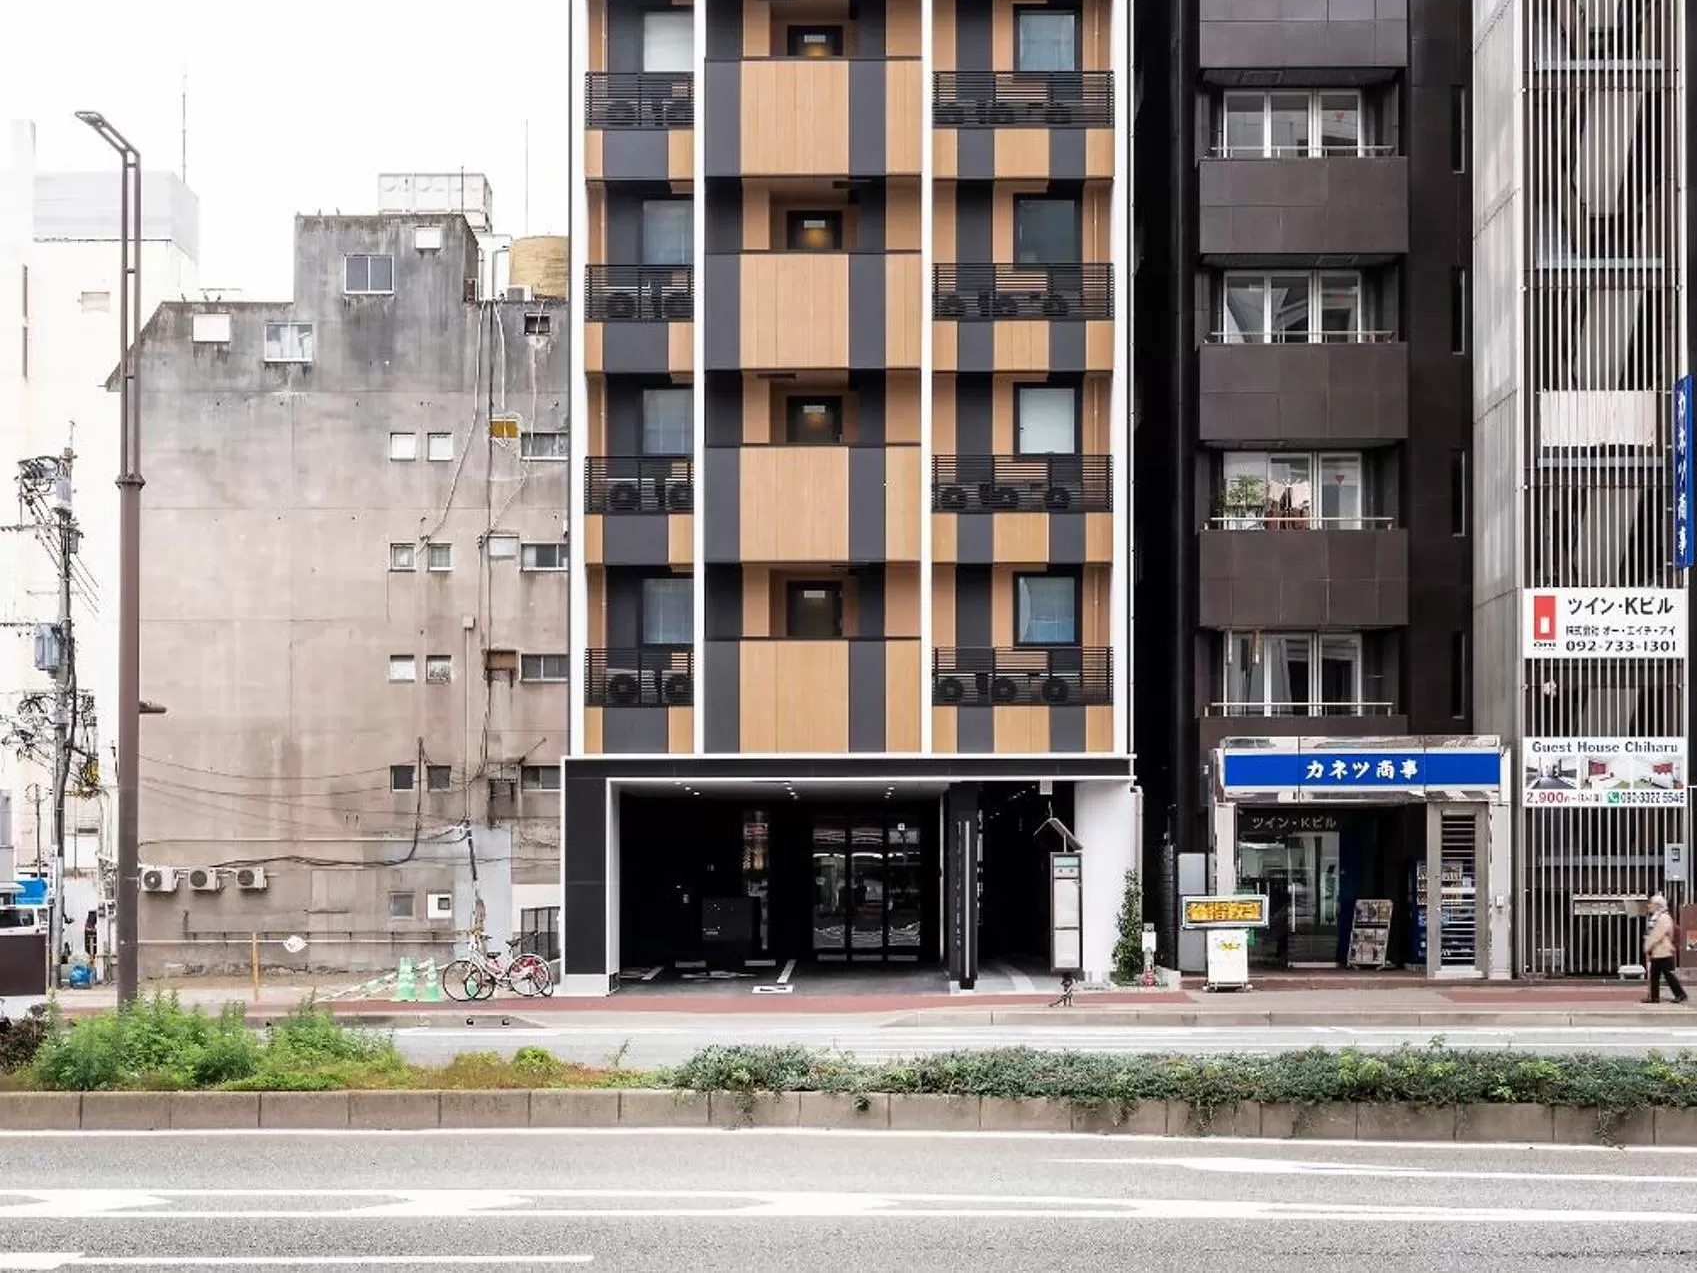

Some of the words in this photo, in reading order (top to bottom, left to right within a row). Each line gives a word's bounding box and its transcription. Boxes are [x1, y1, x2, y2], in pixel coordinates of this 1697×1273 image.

[1568, 596, 1674, 616] ツイン・Kビル
[1566, 640, 1676, 652] 092-733-1301
[1532, 741, 1572, 753] Guest
[1578, 741, 1619, 753] House
[1625, 741, 1678, 753] Chiharu
[1305, 759, 1418, 780] カネツ商事
[1252, 817, 1337, 829] ツイン・Kビル
